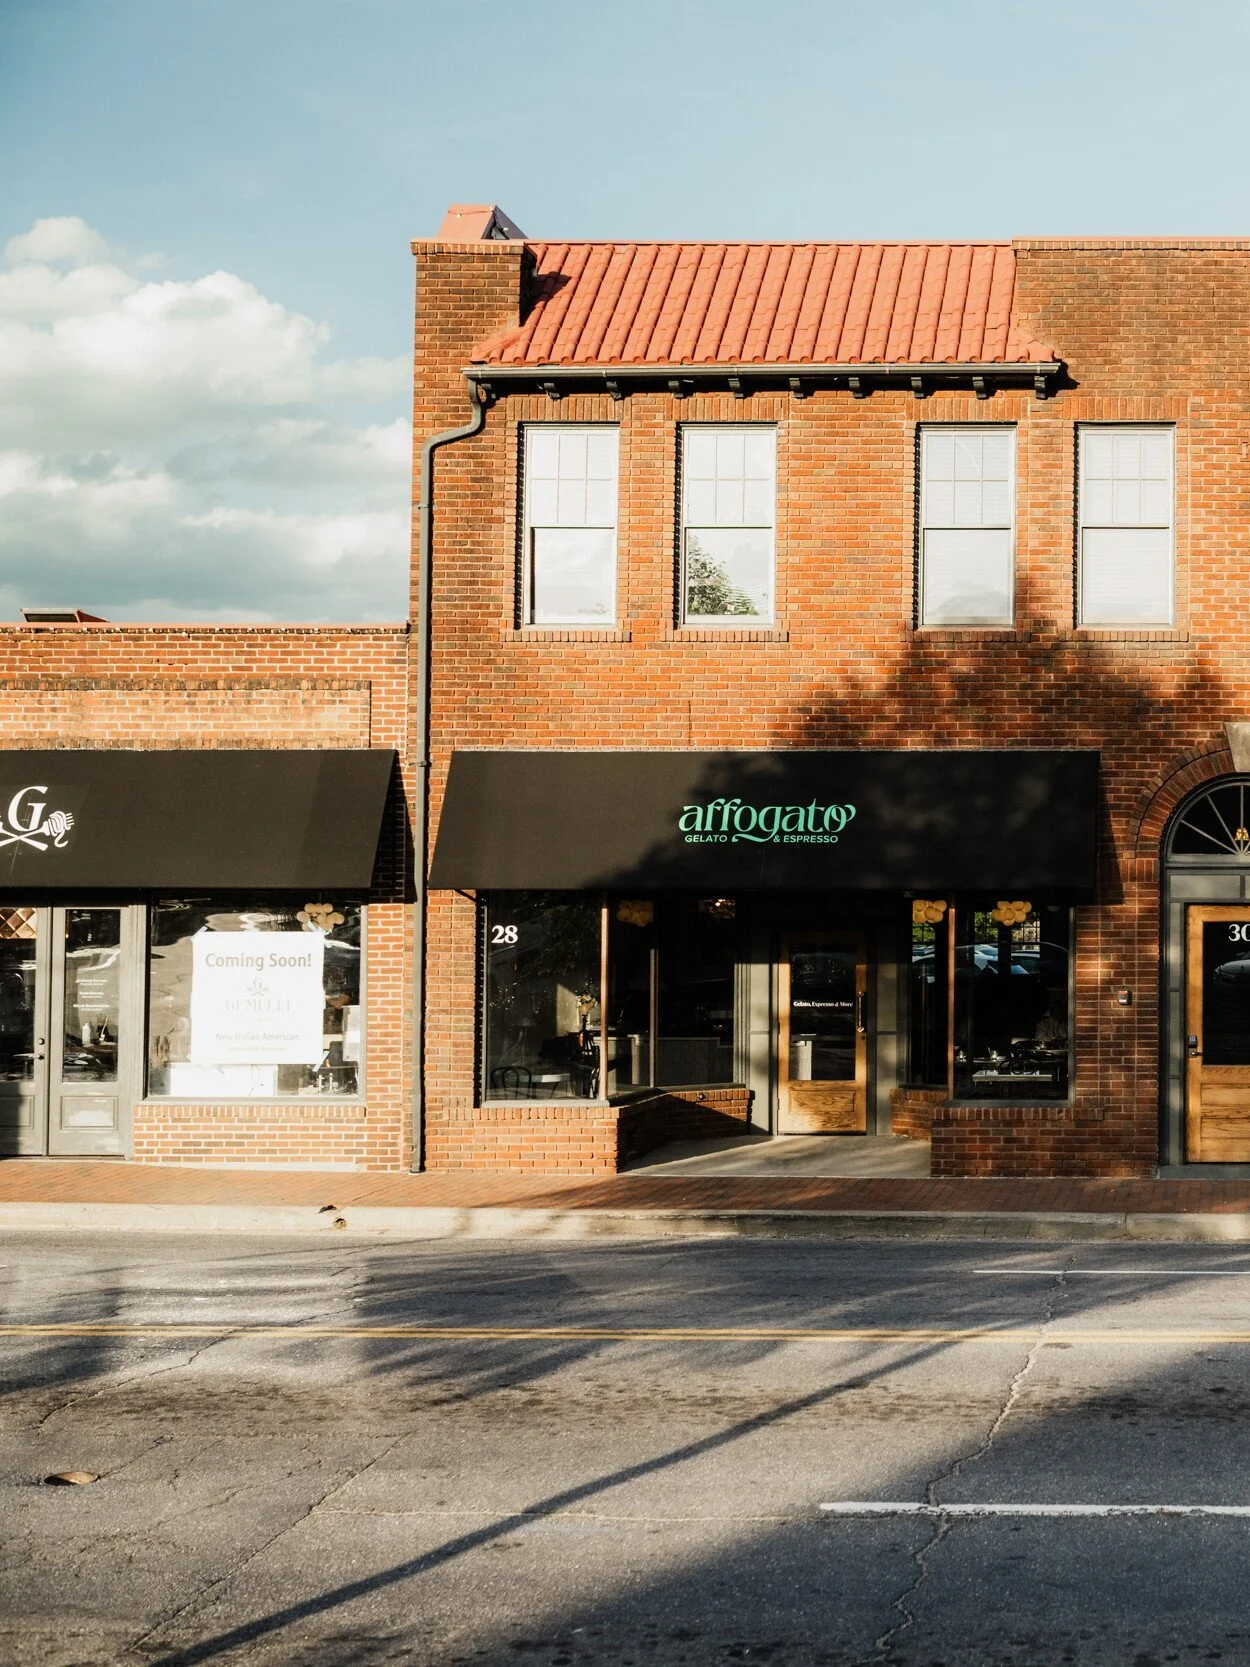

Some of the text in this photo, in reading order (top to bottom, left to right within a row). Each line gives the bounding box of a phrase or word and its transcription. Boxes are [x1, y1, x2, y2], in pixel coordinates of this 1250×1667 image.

[8, 786, 48, 832] G
[678, 798, 857, 843] affogato
[684, 834, 839, 843] GELATO & ESPRESSO
[491, 924, 519, 944] 28
[205, 952, 312, 972] Coming Soon!
[216, 1033, 299, 1041] New Italian American
